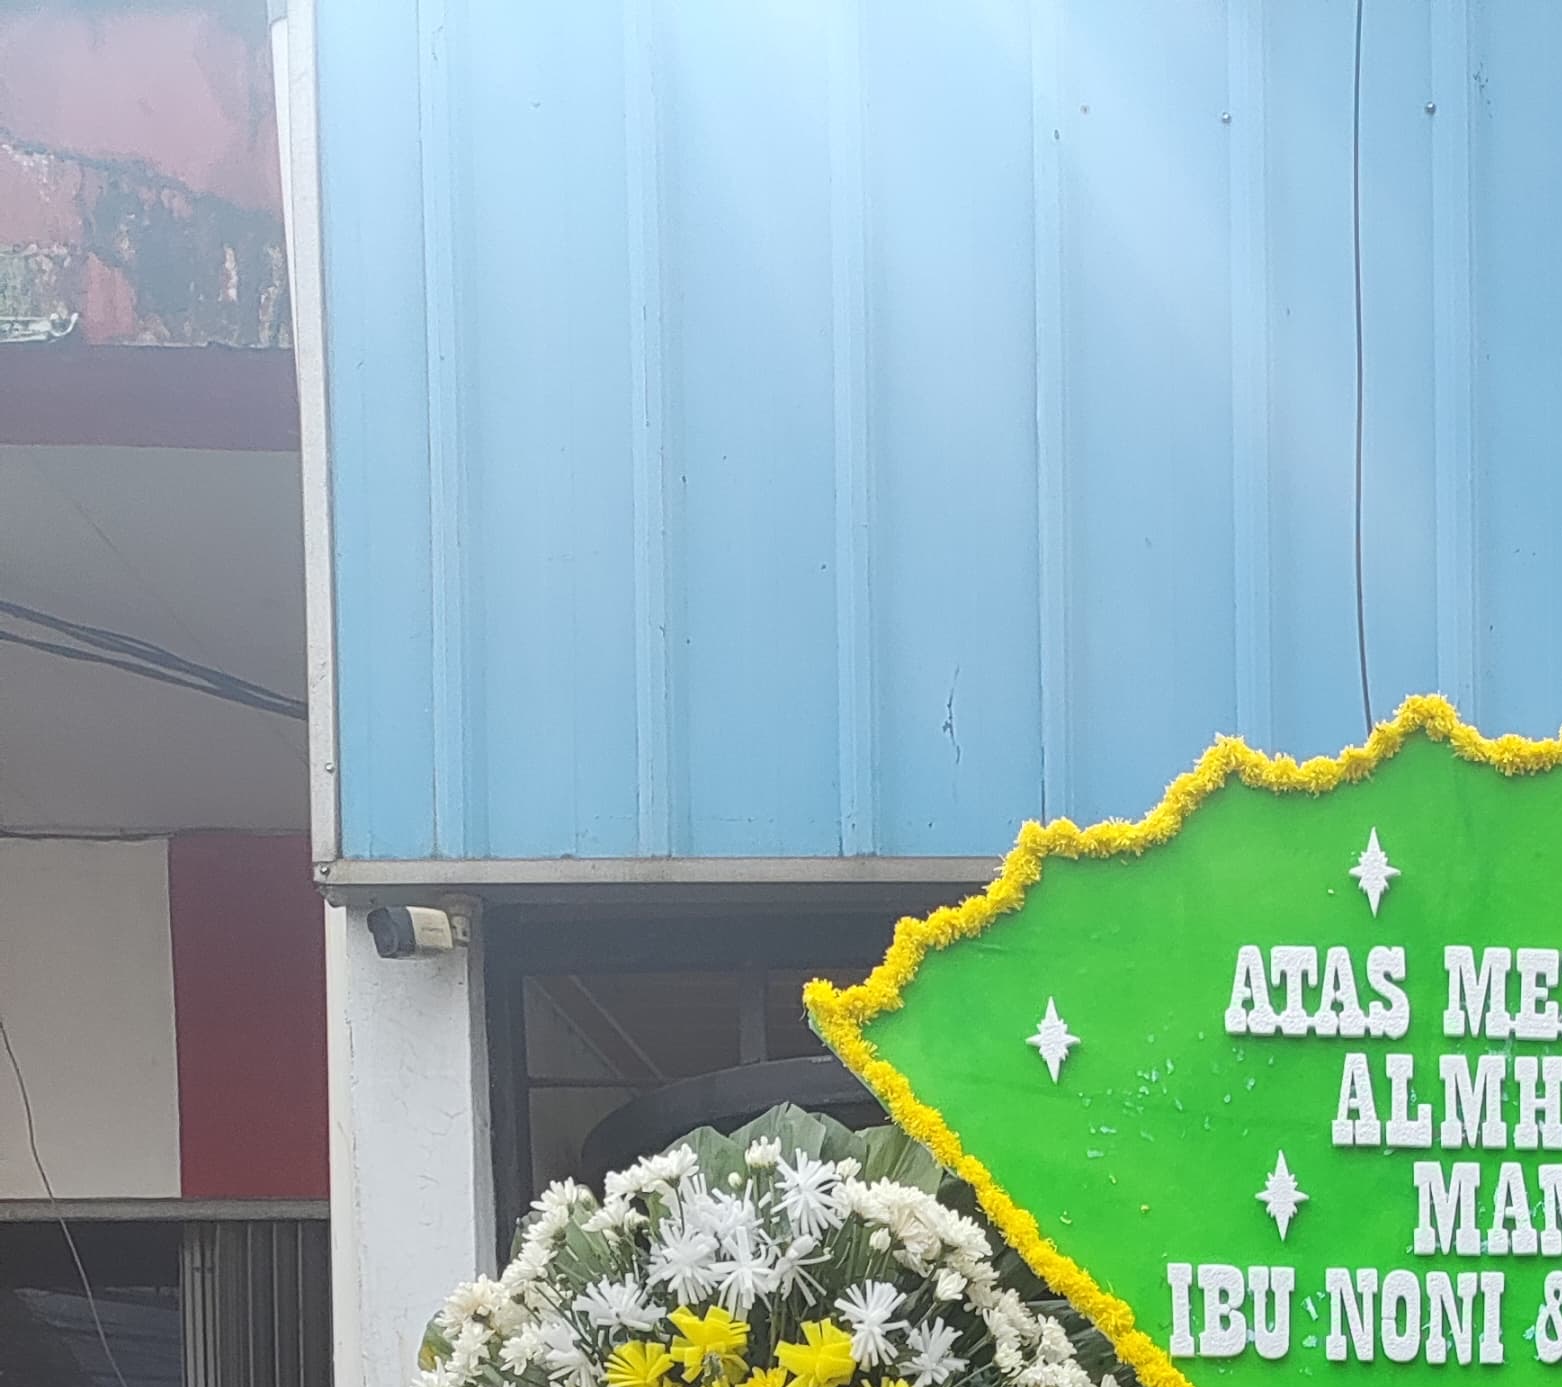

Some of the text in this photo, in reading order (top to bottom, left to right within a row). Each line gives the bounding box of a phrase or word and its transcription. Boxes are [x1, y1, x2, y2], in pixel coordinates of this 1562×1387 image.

[1224, 944, 1411, 1040] ATAS
[1166, 1262, 1296, 1360] IBU
[1325, 1267, 1505, 1365] NONI
